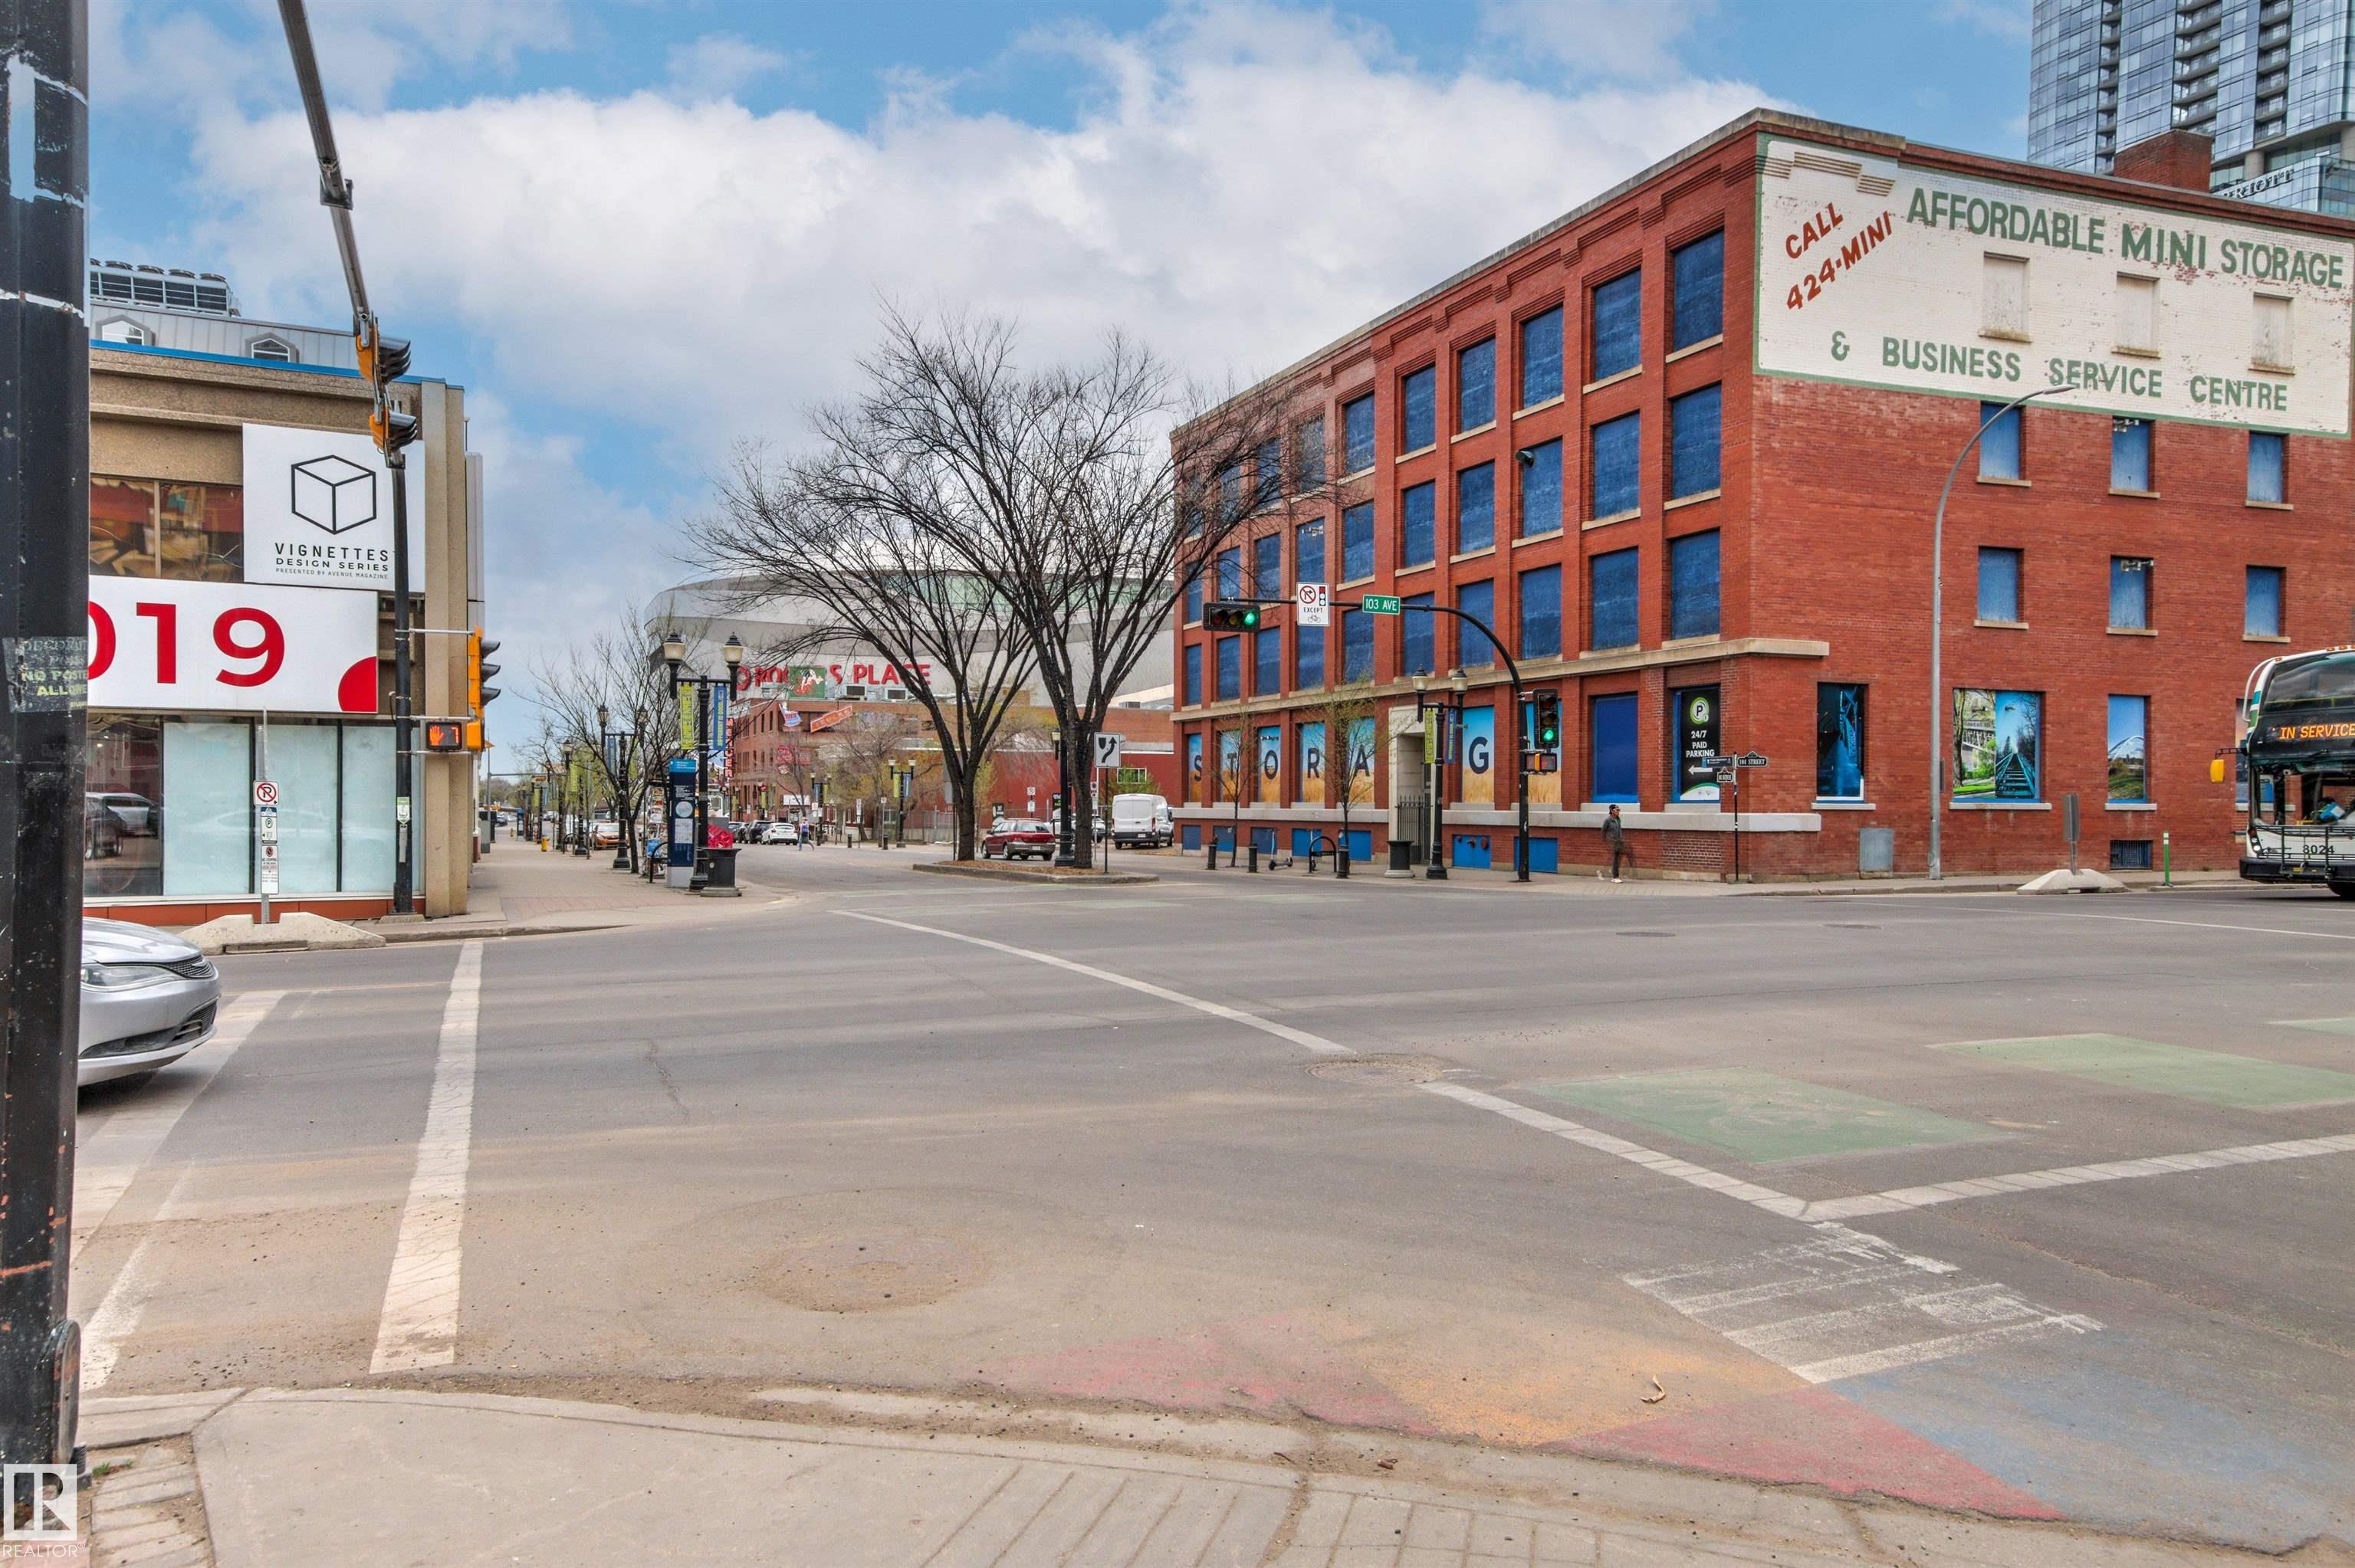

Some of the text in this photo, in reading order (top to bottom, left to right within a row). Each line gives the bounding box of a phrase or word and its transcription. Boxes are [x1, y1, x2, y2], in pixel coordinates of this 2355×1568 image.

[1785, 202, 1844, 258] CALL
[1907, 188, 2343, 288] AFFORDABLE MINI STORAGE
[1831, 330, 2287, 411] & BUSINESS SERVICE CENTRE
[274, 543, 389, 562] VIGNETTES
[276, 557, 389, 572] DESIGN SERIES
[1365, 598, 1398, 611] 103 AVE
[51, 669, 87, 681] POSTE
[754, 664, 842, 687] ROS
[36, 684, 87, 697] ALLOWE
[1696, 705, 1703, 717] P
[1690, 730, 1707, 739] 24/7
[2280, 723, 2355, 740] IN SERVICE
[1692, 741, 1707, 750] PAID
[1686, 749, 1715, 758] PARKING
[2302, 845, 2335, 855] 8024
